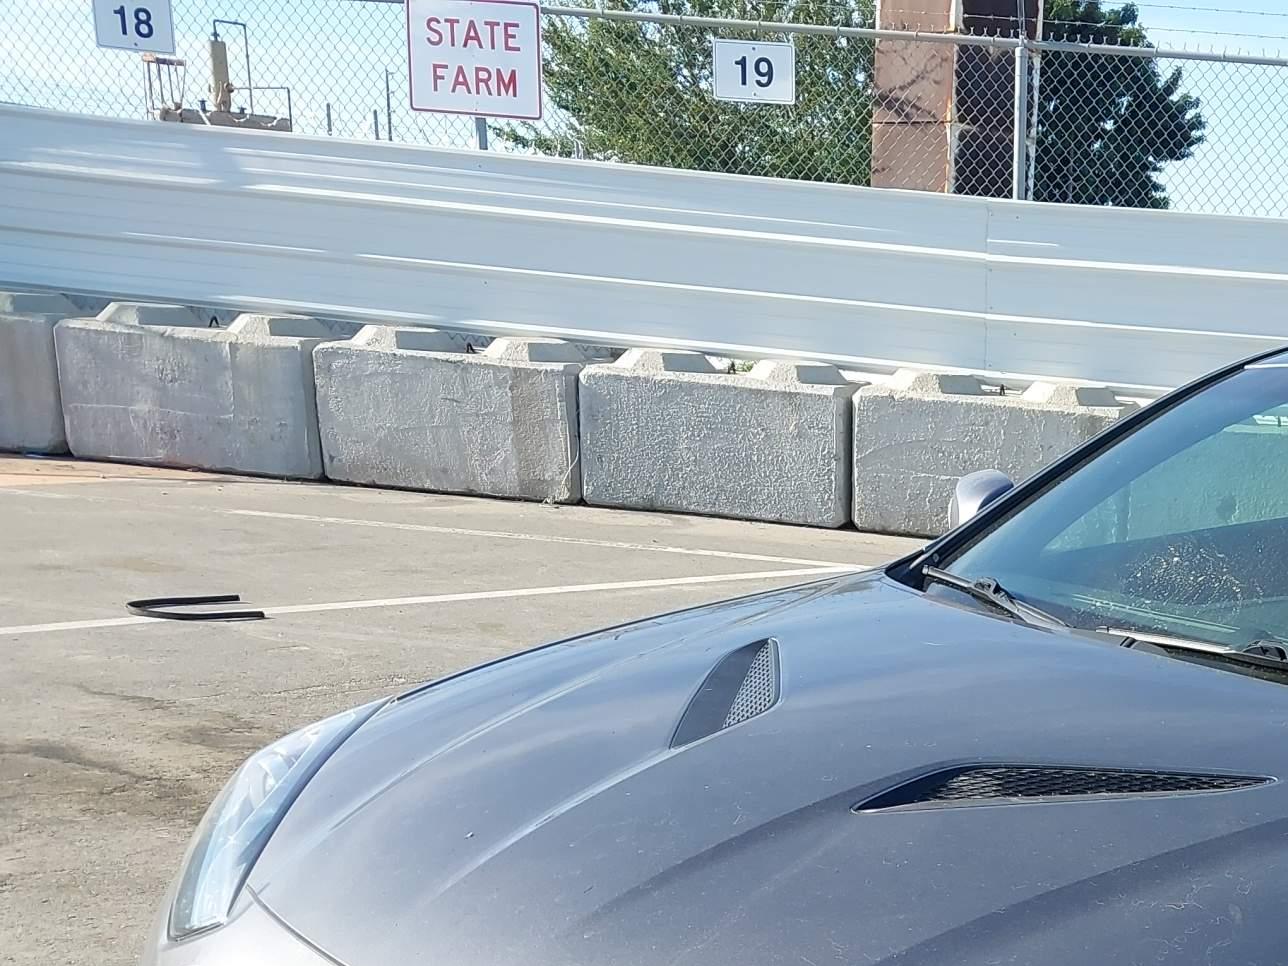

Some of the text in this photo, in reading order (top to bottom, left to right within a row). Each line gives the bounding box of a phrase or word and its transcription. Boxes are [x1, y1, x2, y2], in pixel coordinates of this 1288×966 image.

[113, 5, 154, 39] 18
[426, 16, 521, 52] STATE
[432, 63, 518, 98] FARM
[734, 55, 774, 88] 19
